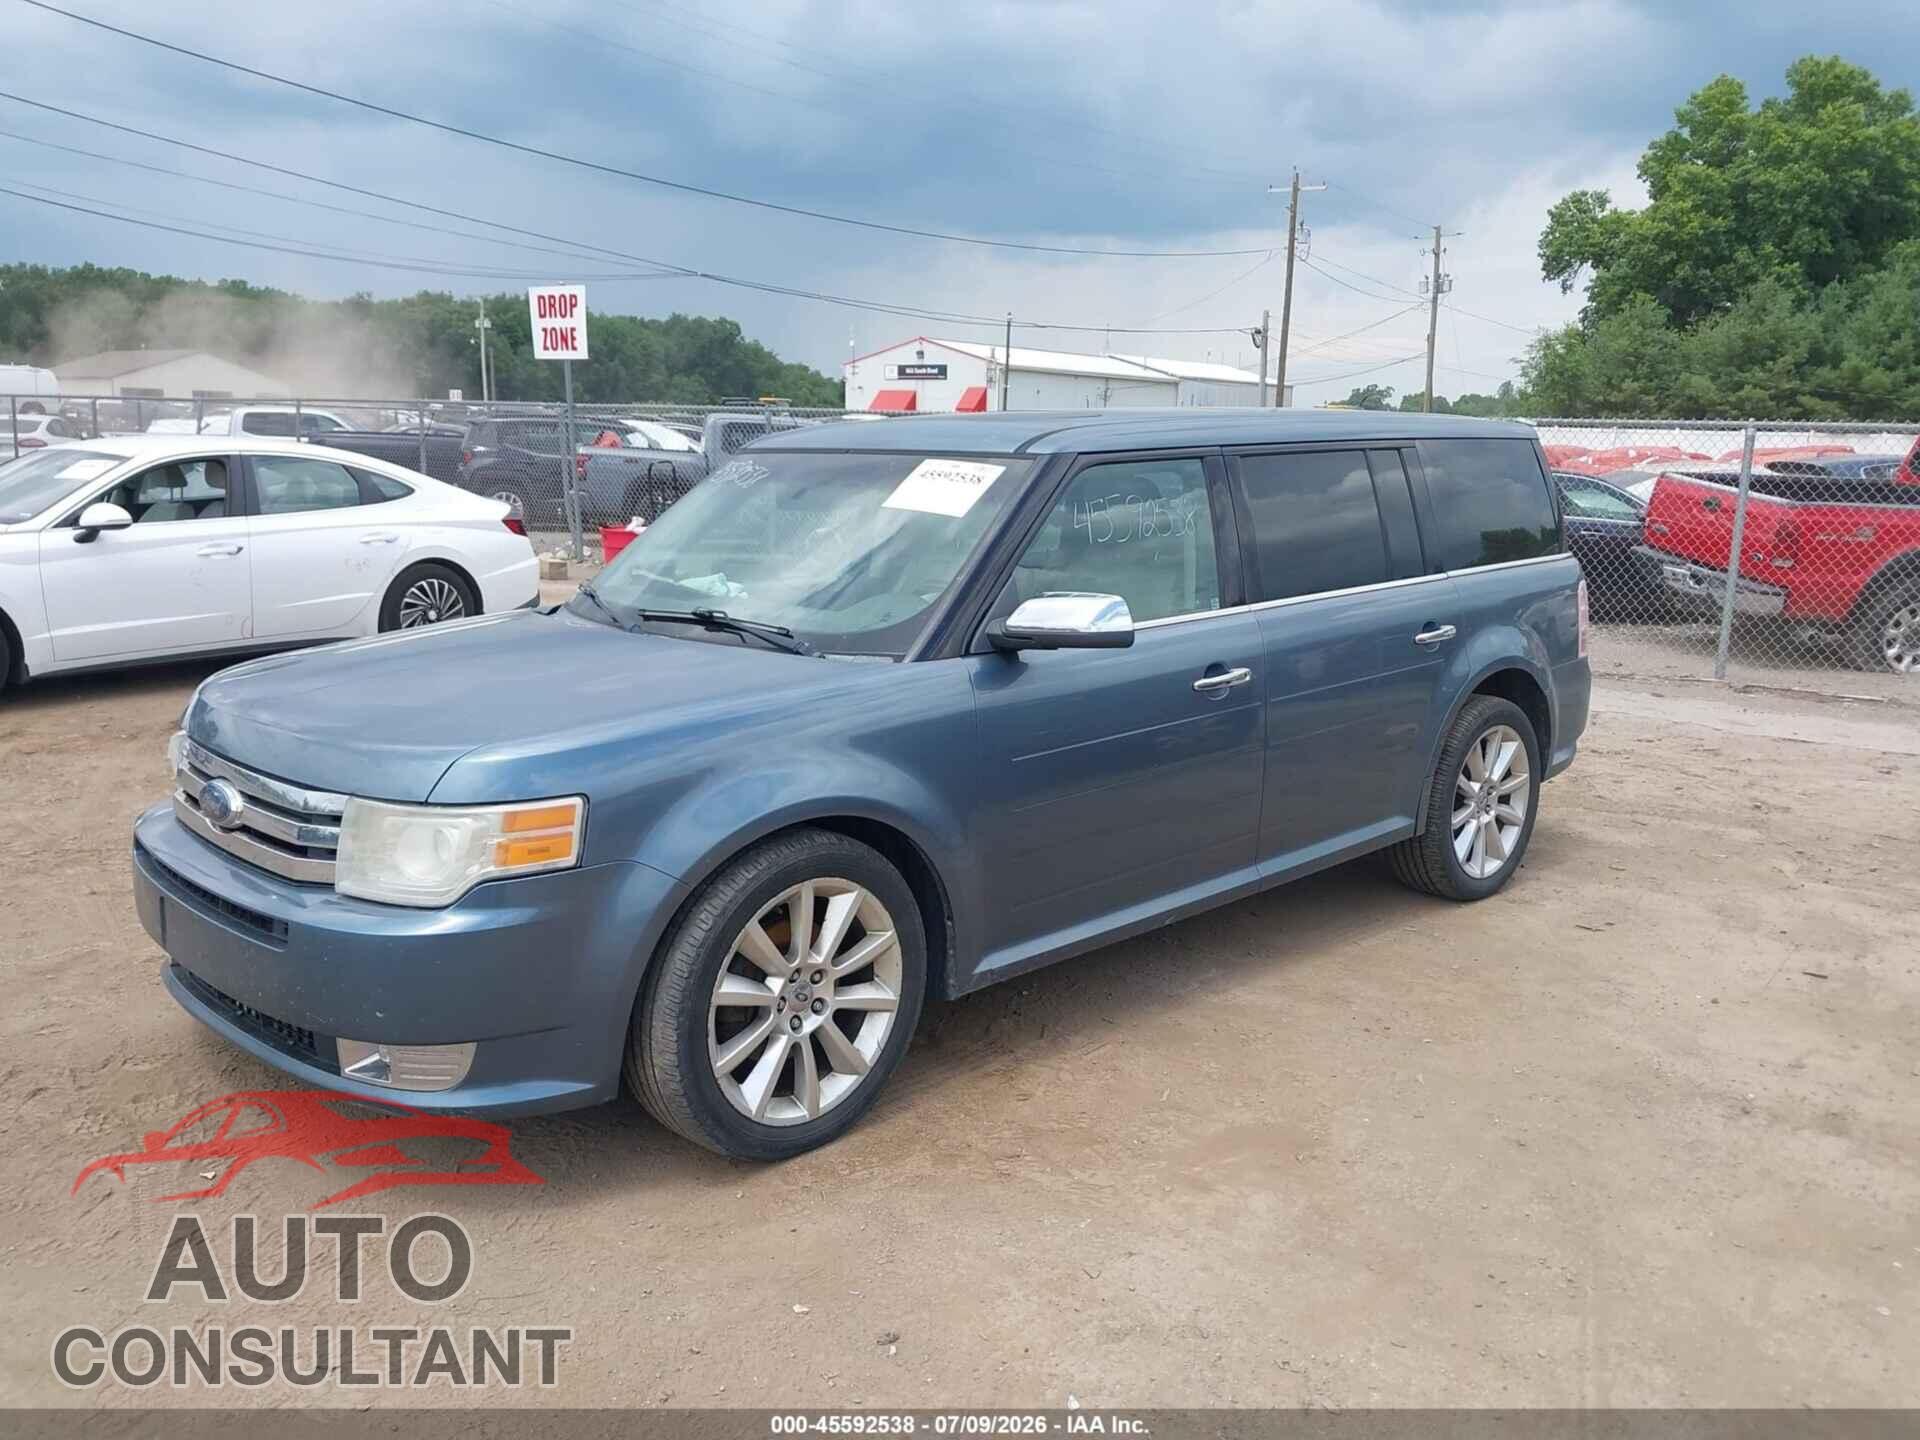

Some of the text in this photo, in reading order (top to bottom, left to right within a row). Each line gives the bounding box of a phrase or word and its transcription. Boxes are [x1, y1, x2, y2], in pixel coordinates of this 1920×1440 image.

[537, 294, 578, 319] DROP
[542, 326, 578, 352] ZONE
[1073, 493, 1200, 544] 45592538
